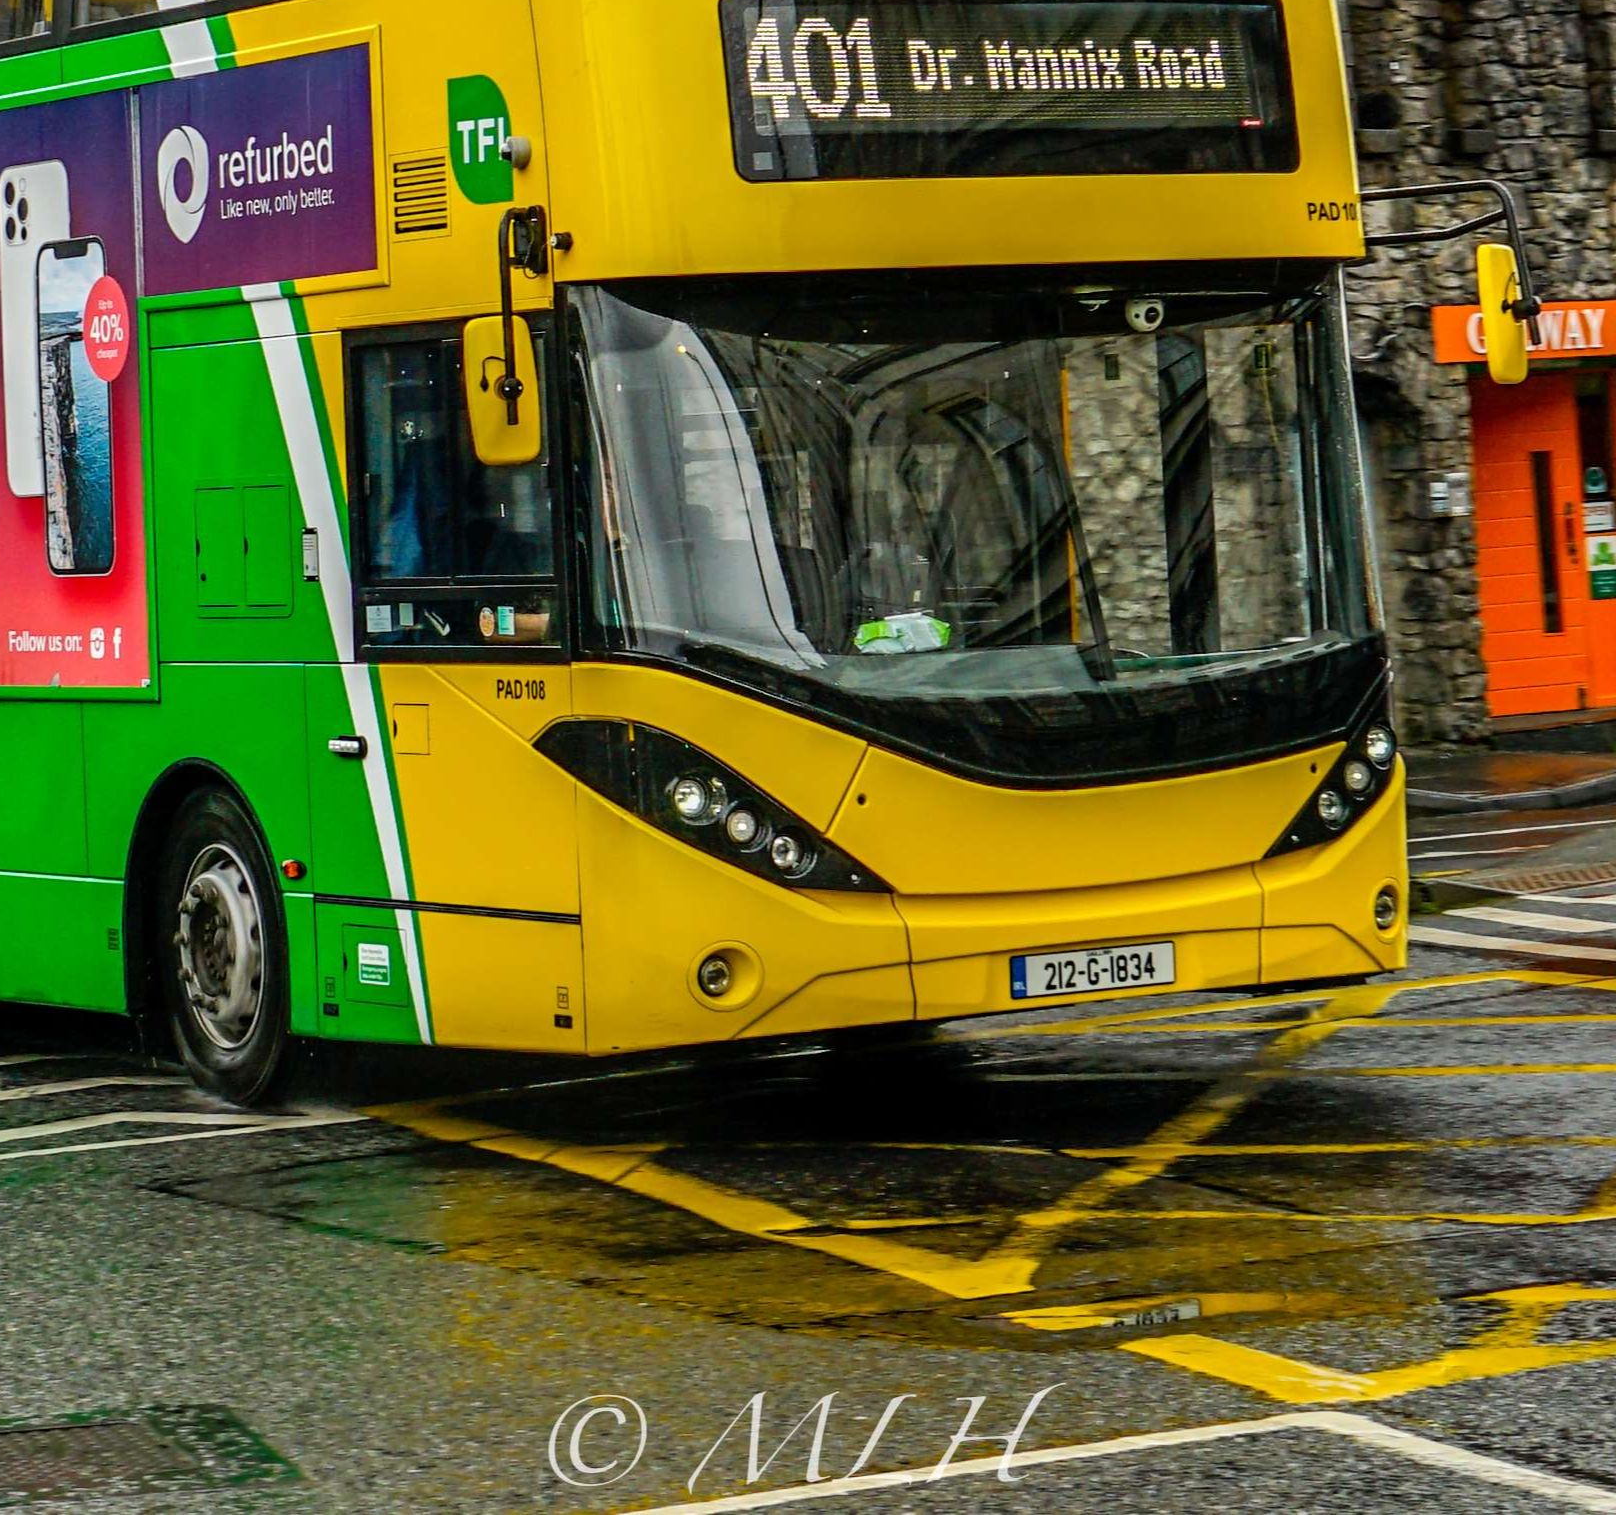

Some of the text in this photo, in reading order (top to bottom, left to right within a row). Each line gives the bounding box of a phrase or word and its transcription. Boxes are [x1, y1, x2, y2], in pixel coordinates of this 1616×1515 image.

[747, 18, 1227, 118] 401 Dr. Mannix Road
[218, 125, 334, 188] refurbed
[220, 187, 335, 220] Like new, only better.
[90, 314, 124, 343] 40%
[8, 630, 46, 652] Follow
[48, 635, 63, 652] us
[64, 635, 83, 652] on:
[1044, 951, 1156, 991] 212-G-1834
